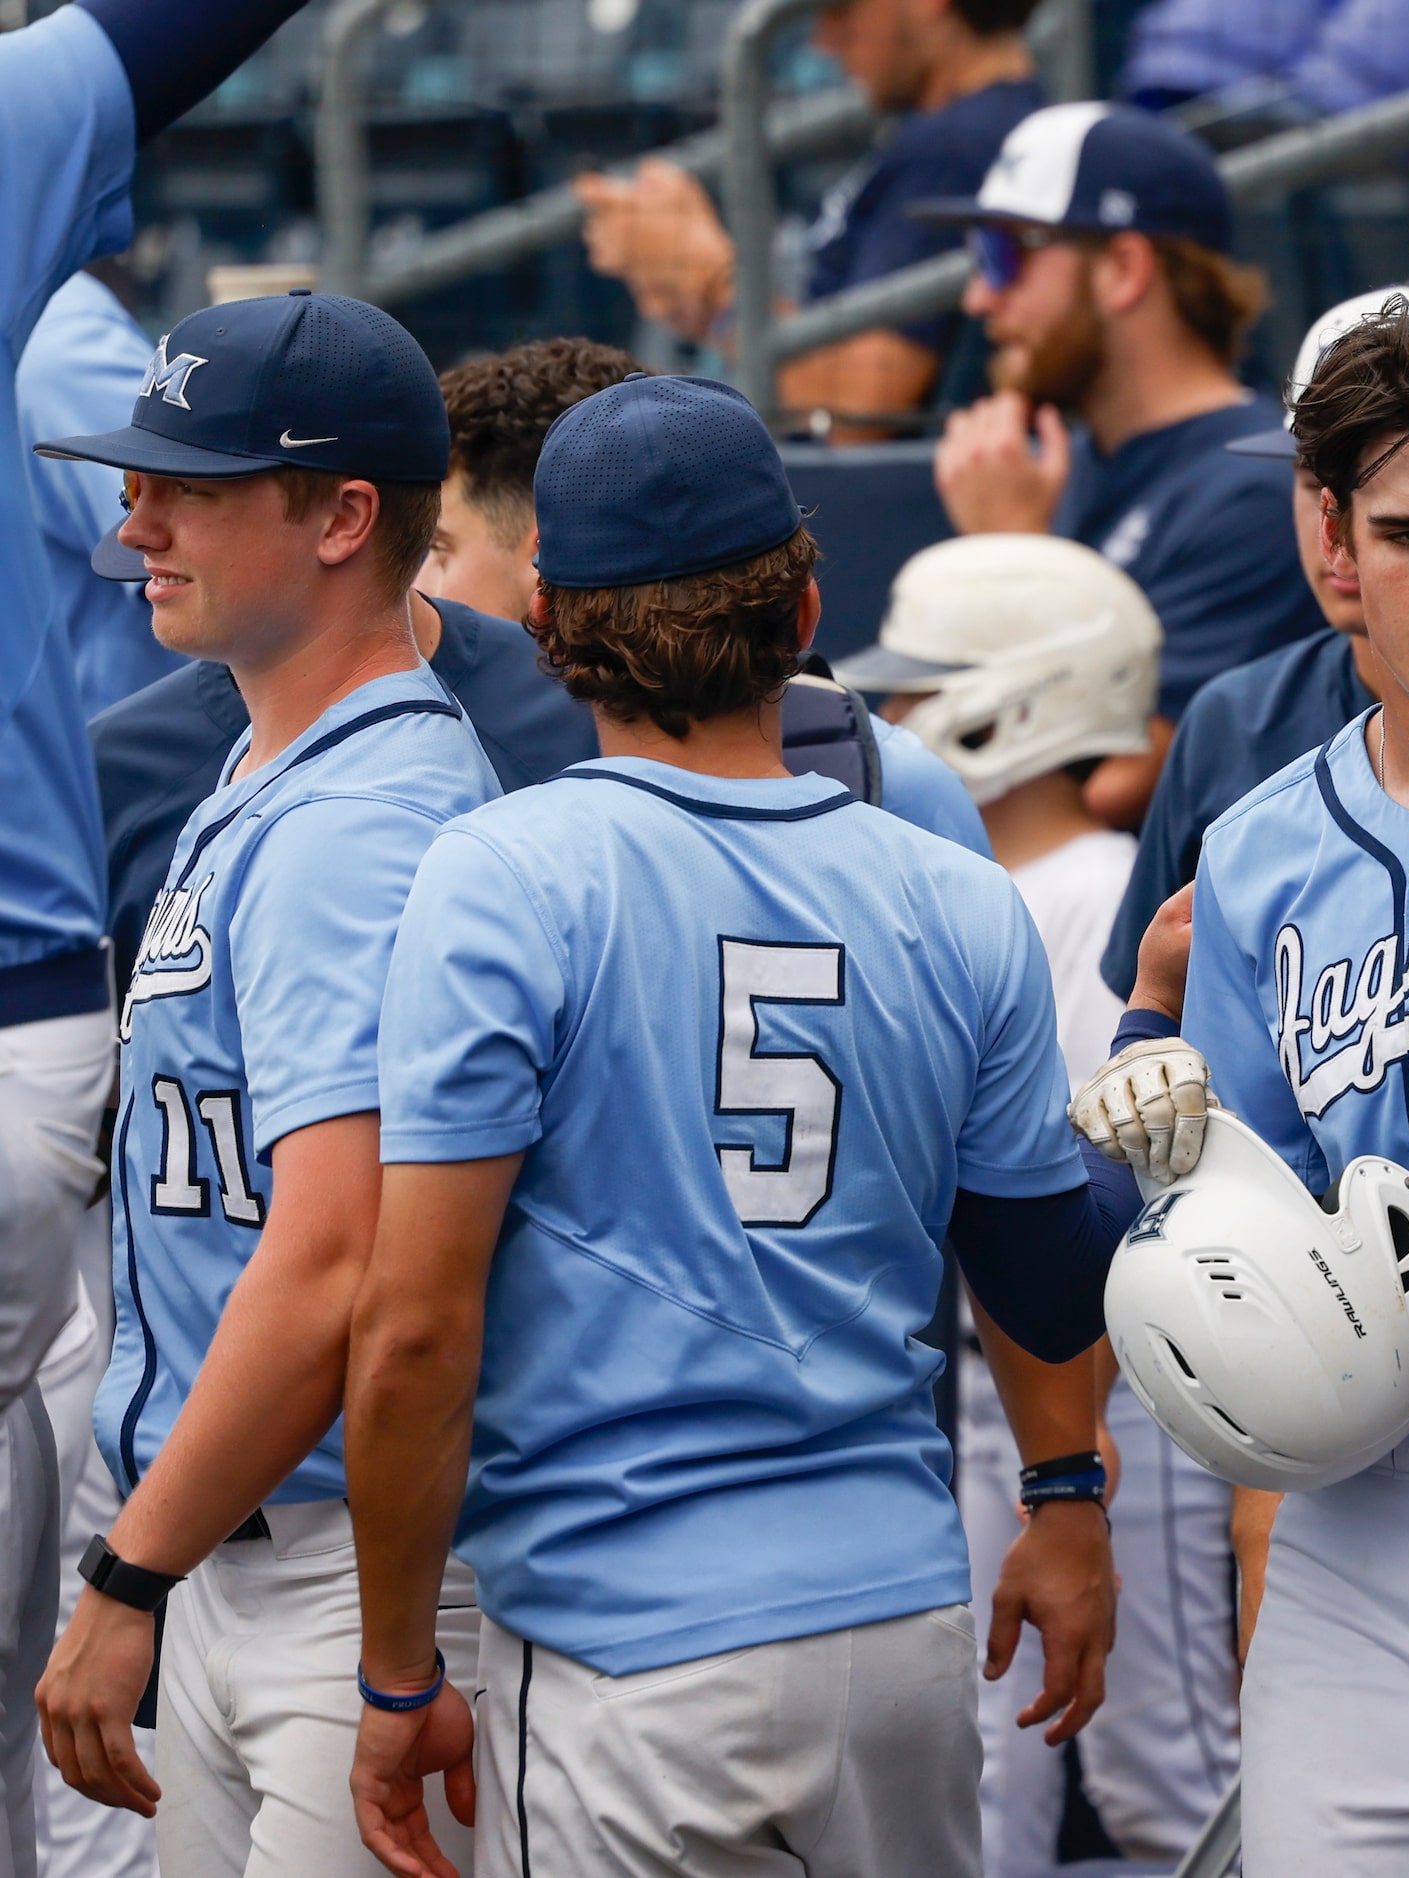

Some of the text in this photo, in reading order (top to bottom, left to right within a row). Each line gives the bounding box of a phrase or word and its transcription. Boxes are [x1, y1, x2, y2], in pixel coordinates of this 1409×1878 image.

[150, 1072, 267, 1230] 11
[713, 934, 845, 1230] 5
[1307, 1247, 1367, 1341] RAWLINGS
